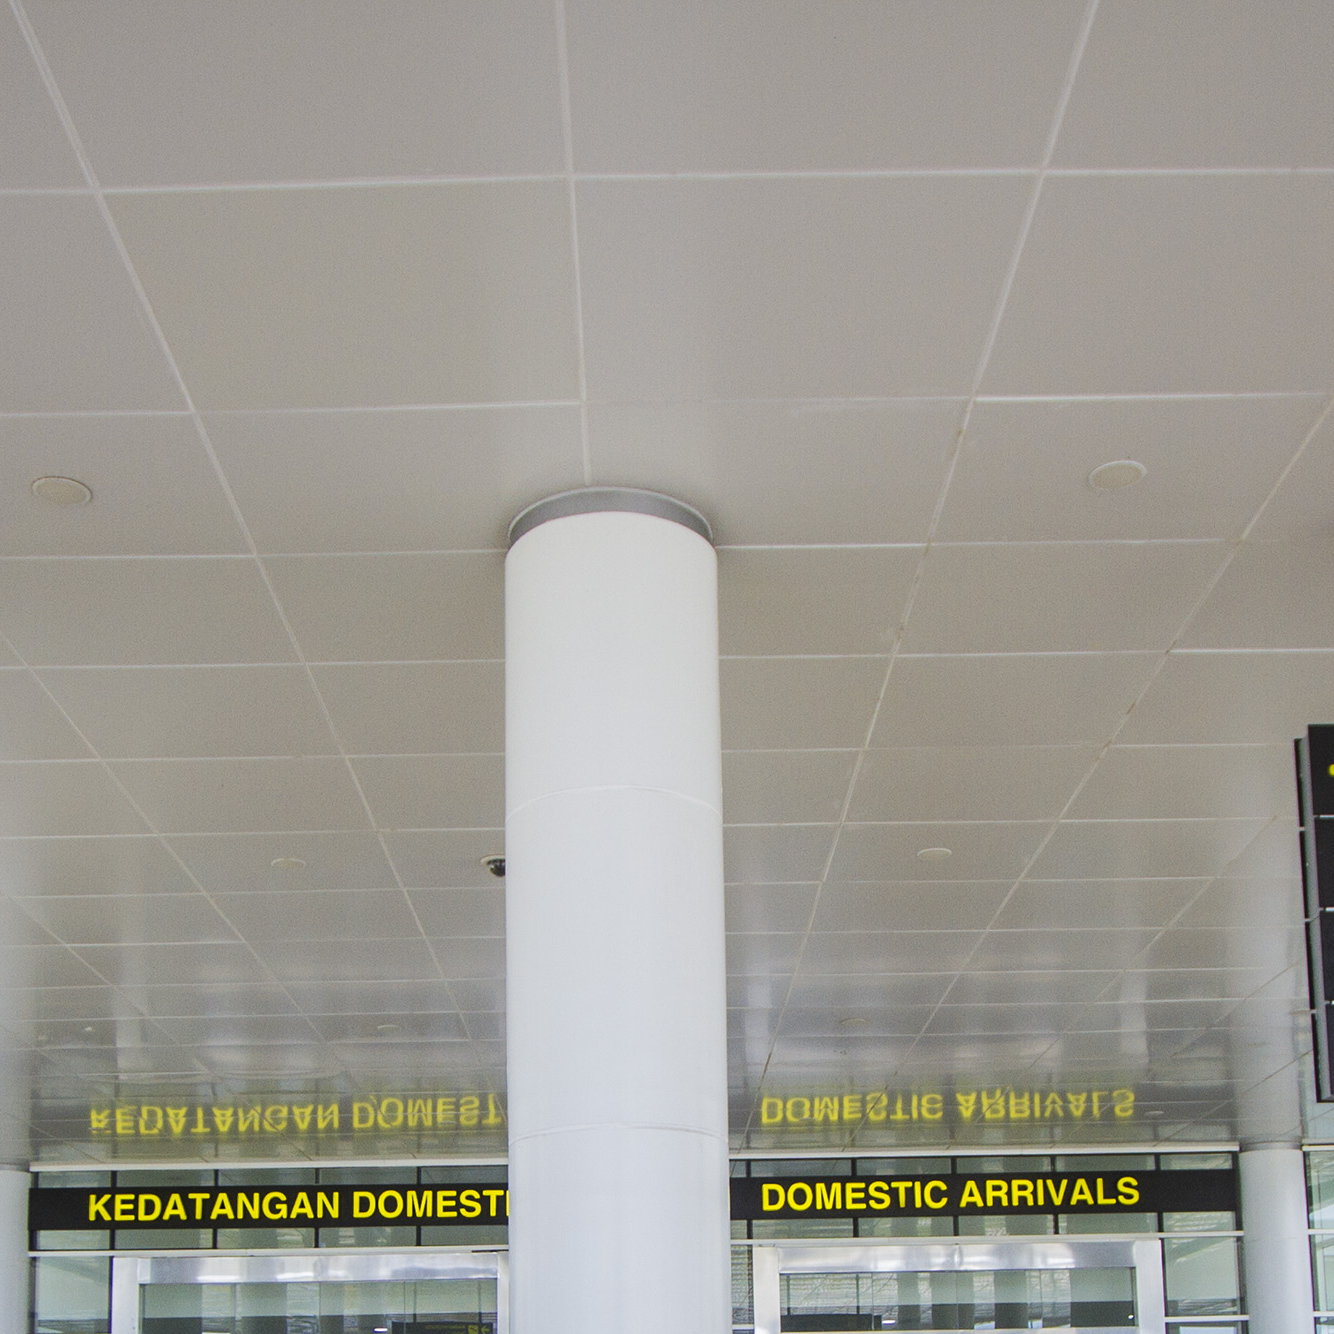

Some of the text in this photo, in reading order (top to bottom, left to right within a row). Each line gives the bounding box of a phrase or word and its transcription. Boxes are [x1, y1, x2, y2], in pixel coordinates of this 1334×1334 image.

[88, 1190, 340, 1222] KEDATANGAN
[761, 1176, 1140, 1212] DOMESTIC ARRIVALS
